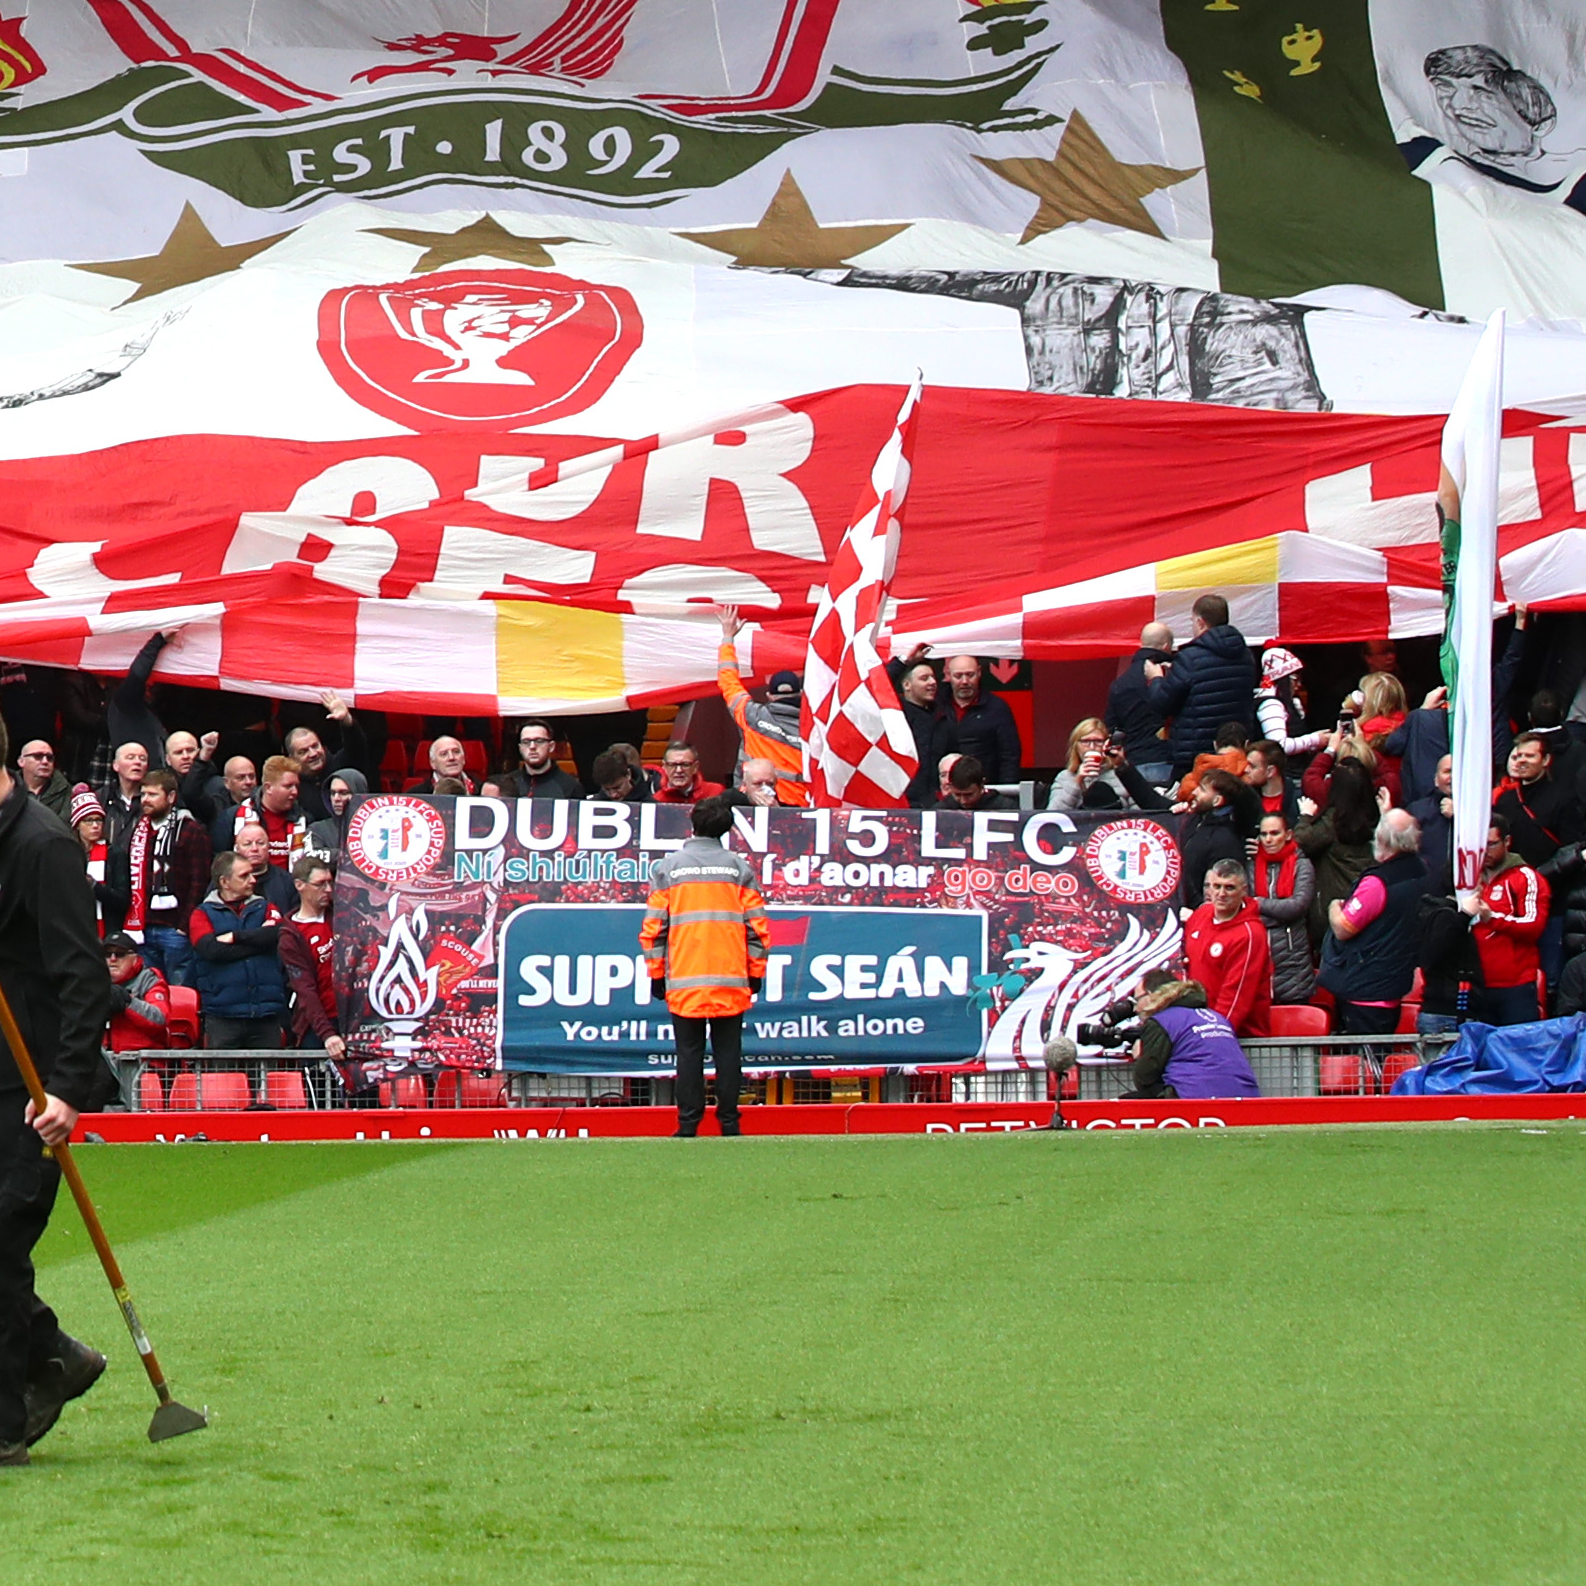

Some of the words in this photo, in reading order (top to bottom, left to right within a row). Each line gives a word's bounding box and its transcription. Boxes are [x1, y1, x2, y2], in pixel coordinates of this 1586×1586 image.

[287, 131, 398, 188] EST
[484, 118, 682, 182] 1892
[349, 796, 390, 838] DUBLIN
[392, 796, 408, 806] 15
[410, 797, 436, 820] LFC
[454, 796, 769, 853] DUBLN
[801, 807, 889, 857] 15
[920, 810, 1078, 866] LFC
[1086, 819, 1128, 855] DUBLIN
[1129, 819, 1145, 830] 15
[1147, 822, 1172, 847] LFC
[348, 839, 378, 875] CLUB
[378, 819, 444, 881] SUPPORTERS
[453, 851, 495, 883] Ní
[944, 866, 996, 898] go
[1005, 865, 1079, 896] deo
[670, 866, 699, 878] CROWD
[700, 865, 739, 878] STEWARD
[1086, 858, 1115, 892] CLUB
[1115, 848, 1179, 902] SUPPORTERS
[440, 938, 480, 967] SCOUSE
[517, 953, 792, 1007] SUPT
[808, 946, 969, 1001] SEÁN
[757, 1015, 829, 1039] walk
[837, 1014, 926, 1037] alone
